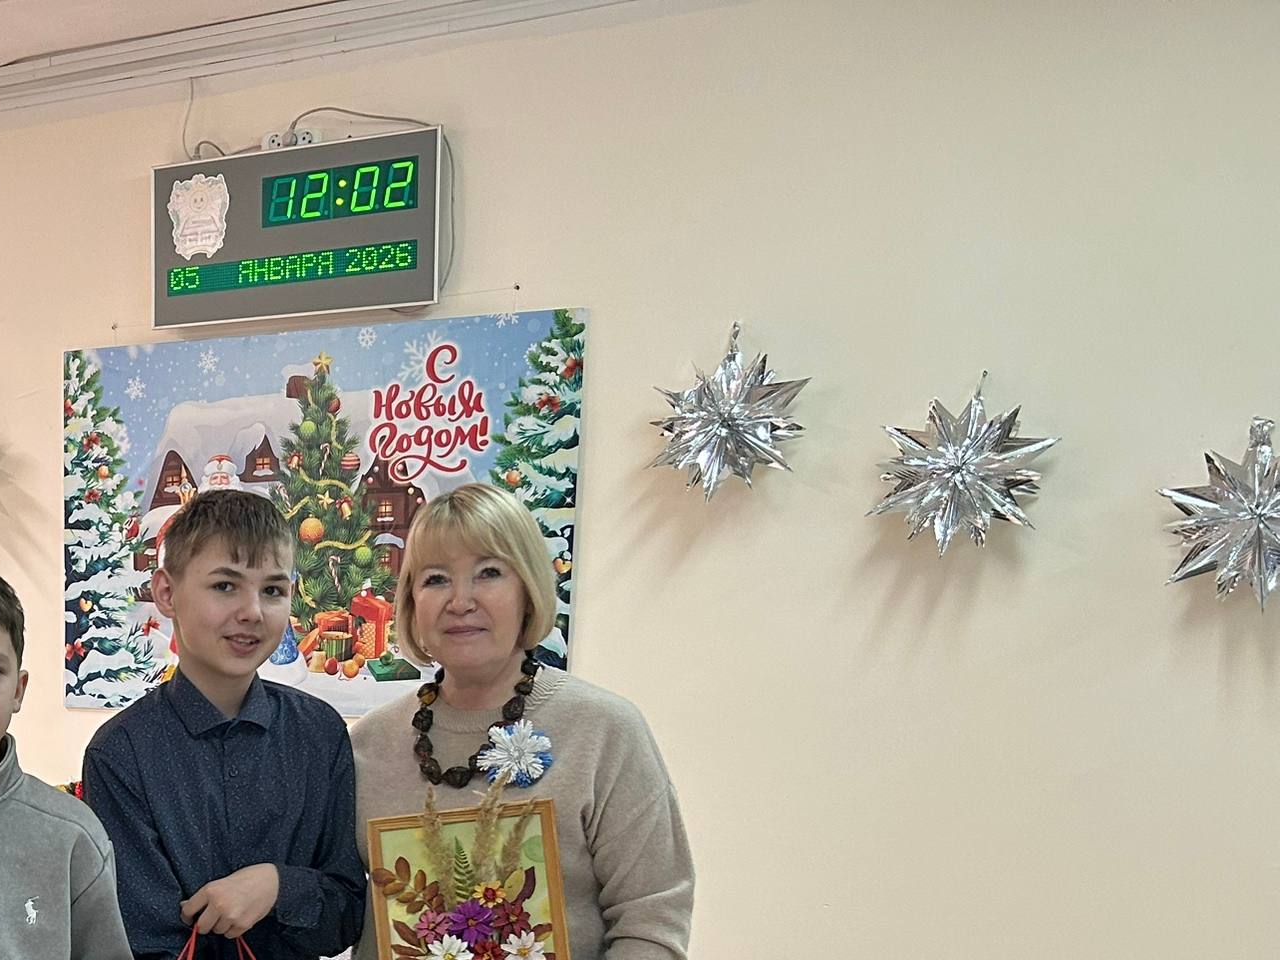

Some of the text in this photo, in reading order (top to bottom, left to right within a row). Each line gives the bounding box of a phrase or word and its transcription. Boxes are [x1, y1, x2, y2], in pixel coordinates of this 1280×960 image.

[286, 161, 414, 218] 12:02
[170, 242, 413, 290] 05 ЯНВАРЯ 2026
[425, 344, 458, 384] С
[373, 380, 485, 422] Новым
